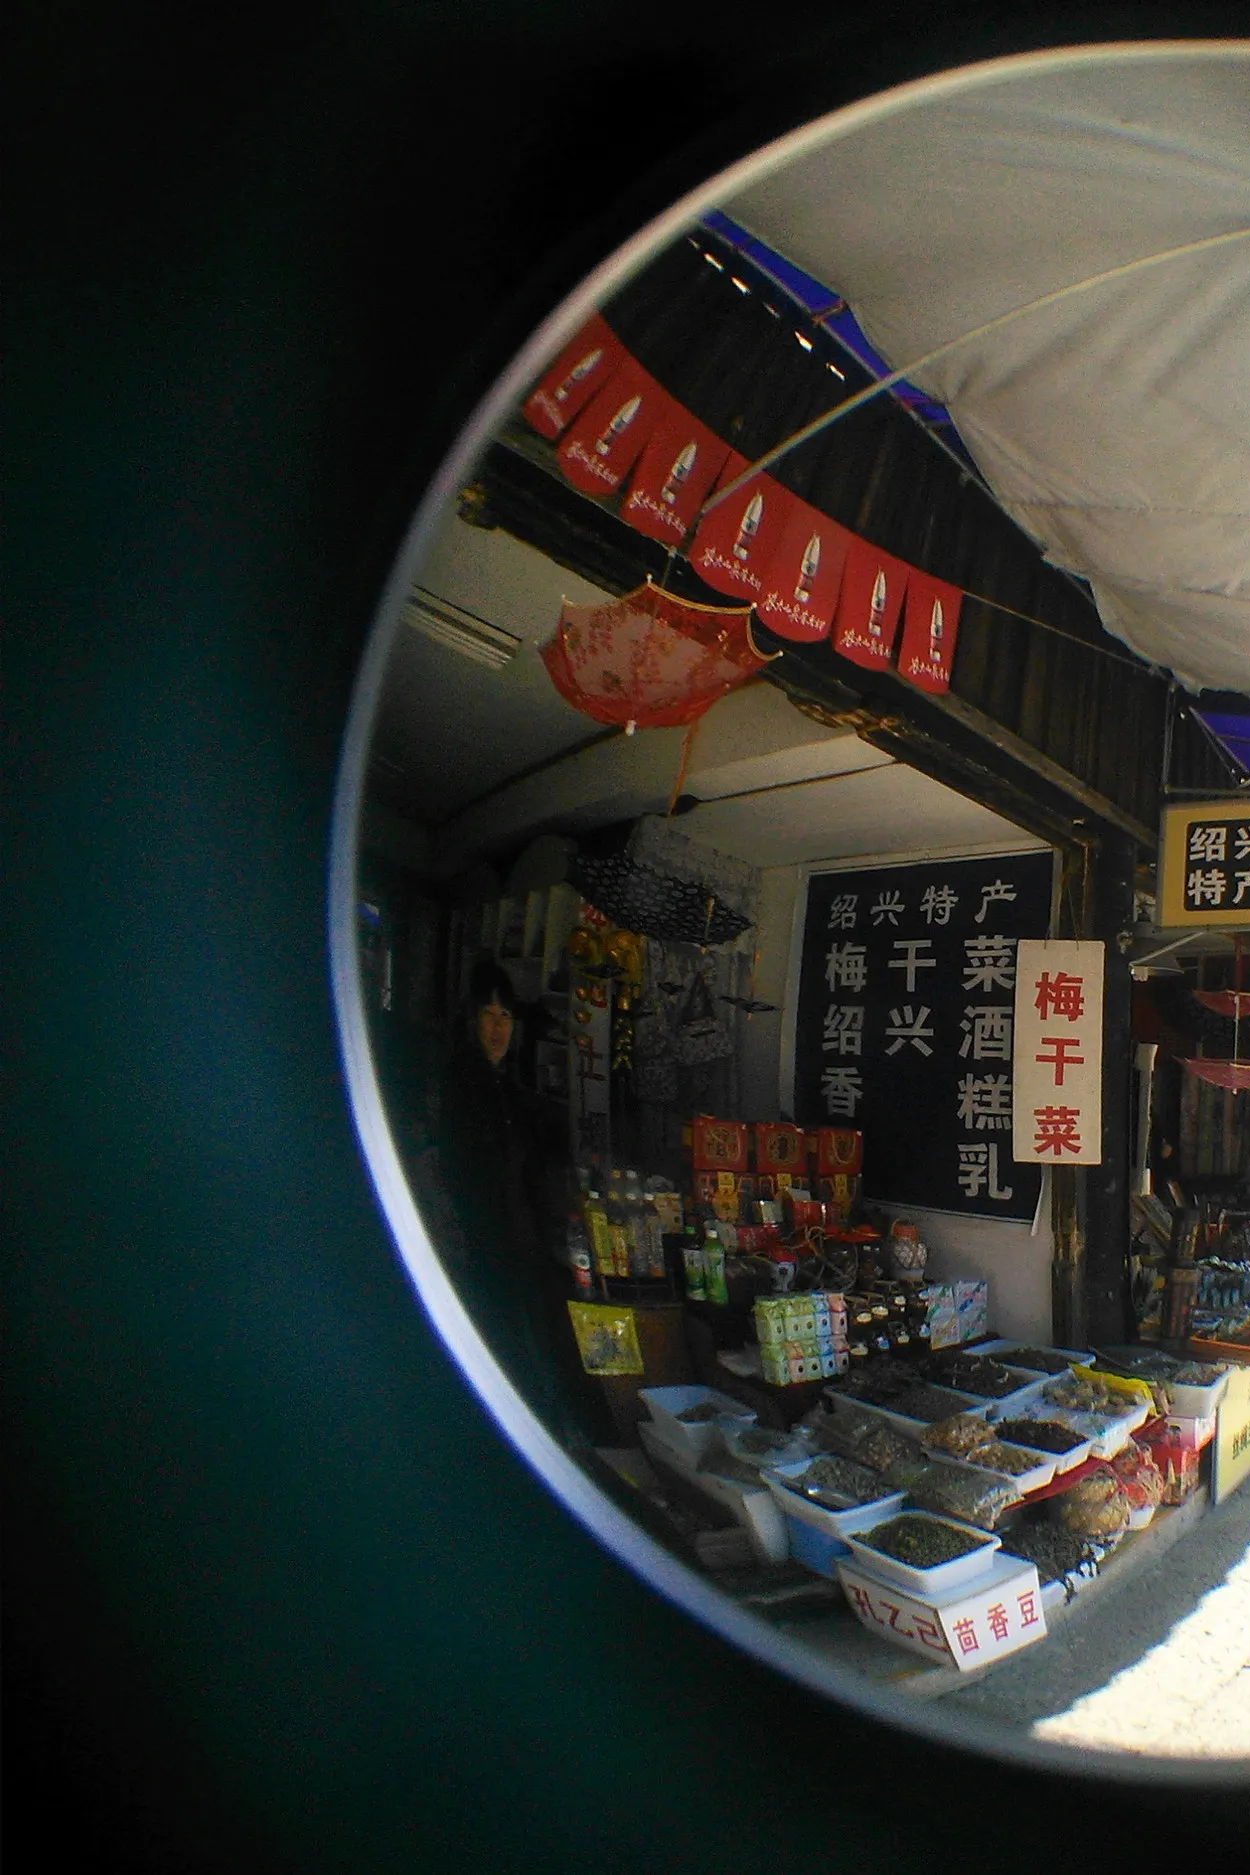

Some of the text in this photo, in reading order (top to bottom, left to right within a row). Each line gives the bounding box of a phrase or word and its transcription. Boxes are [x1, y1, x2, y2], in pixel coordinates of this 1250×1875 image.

[827, 879, 1018, 930] 绍兴特产
[824, 934, 1018, 994] 梅干菜
[1033, 971, 1085, 1157] 梅干菜
[952, 1588, 1040, 1656] 茴香豆
